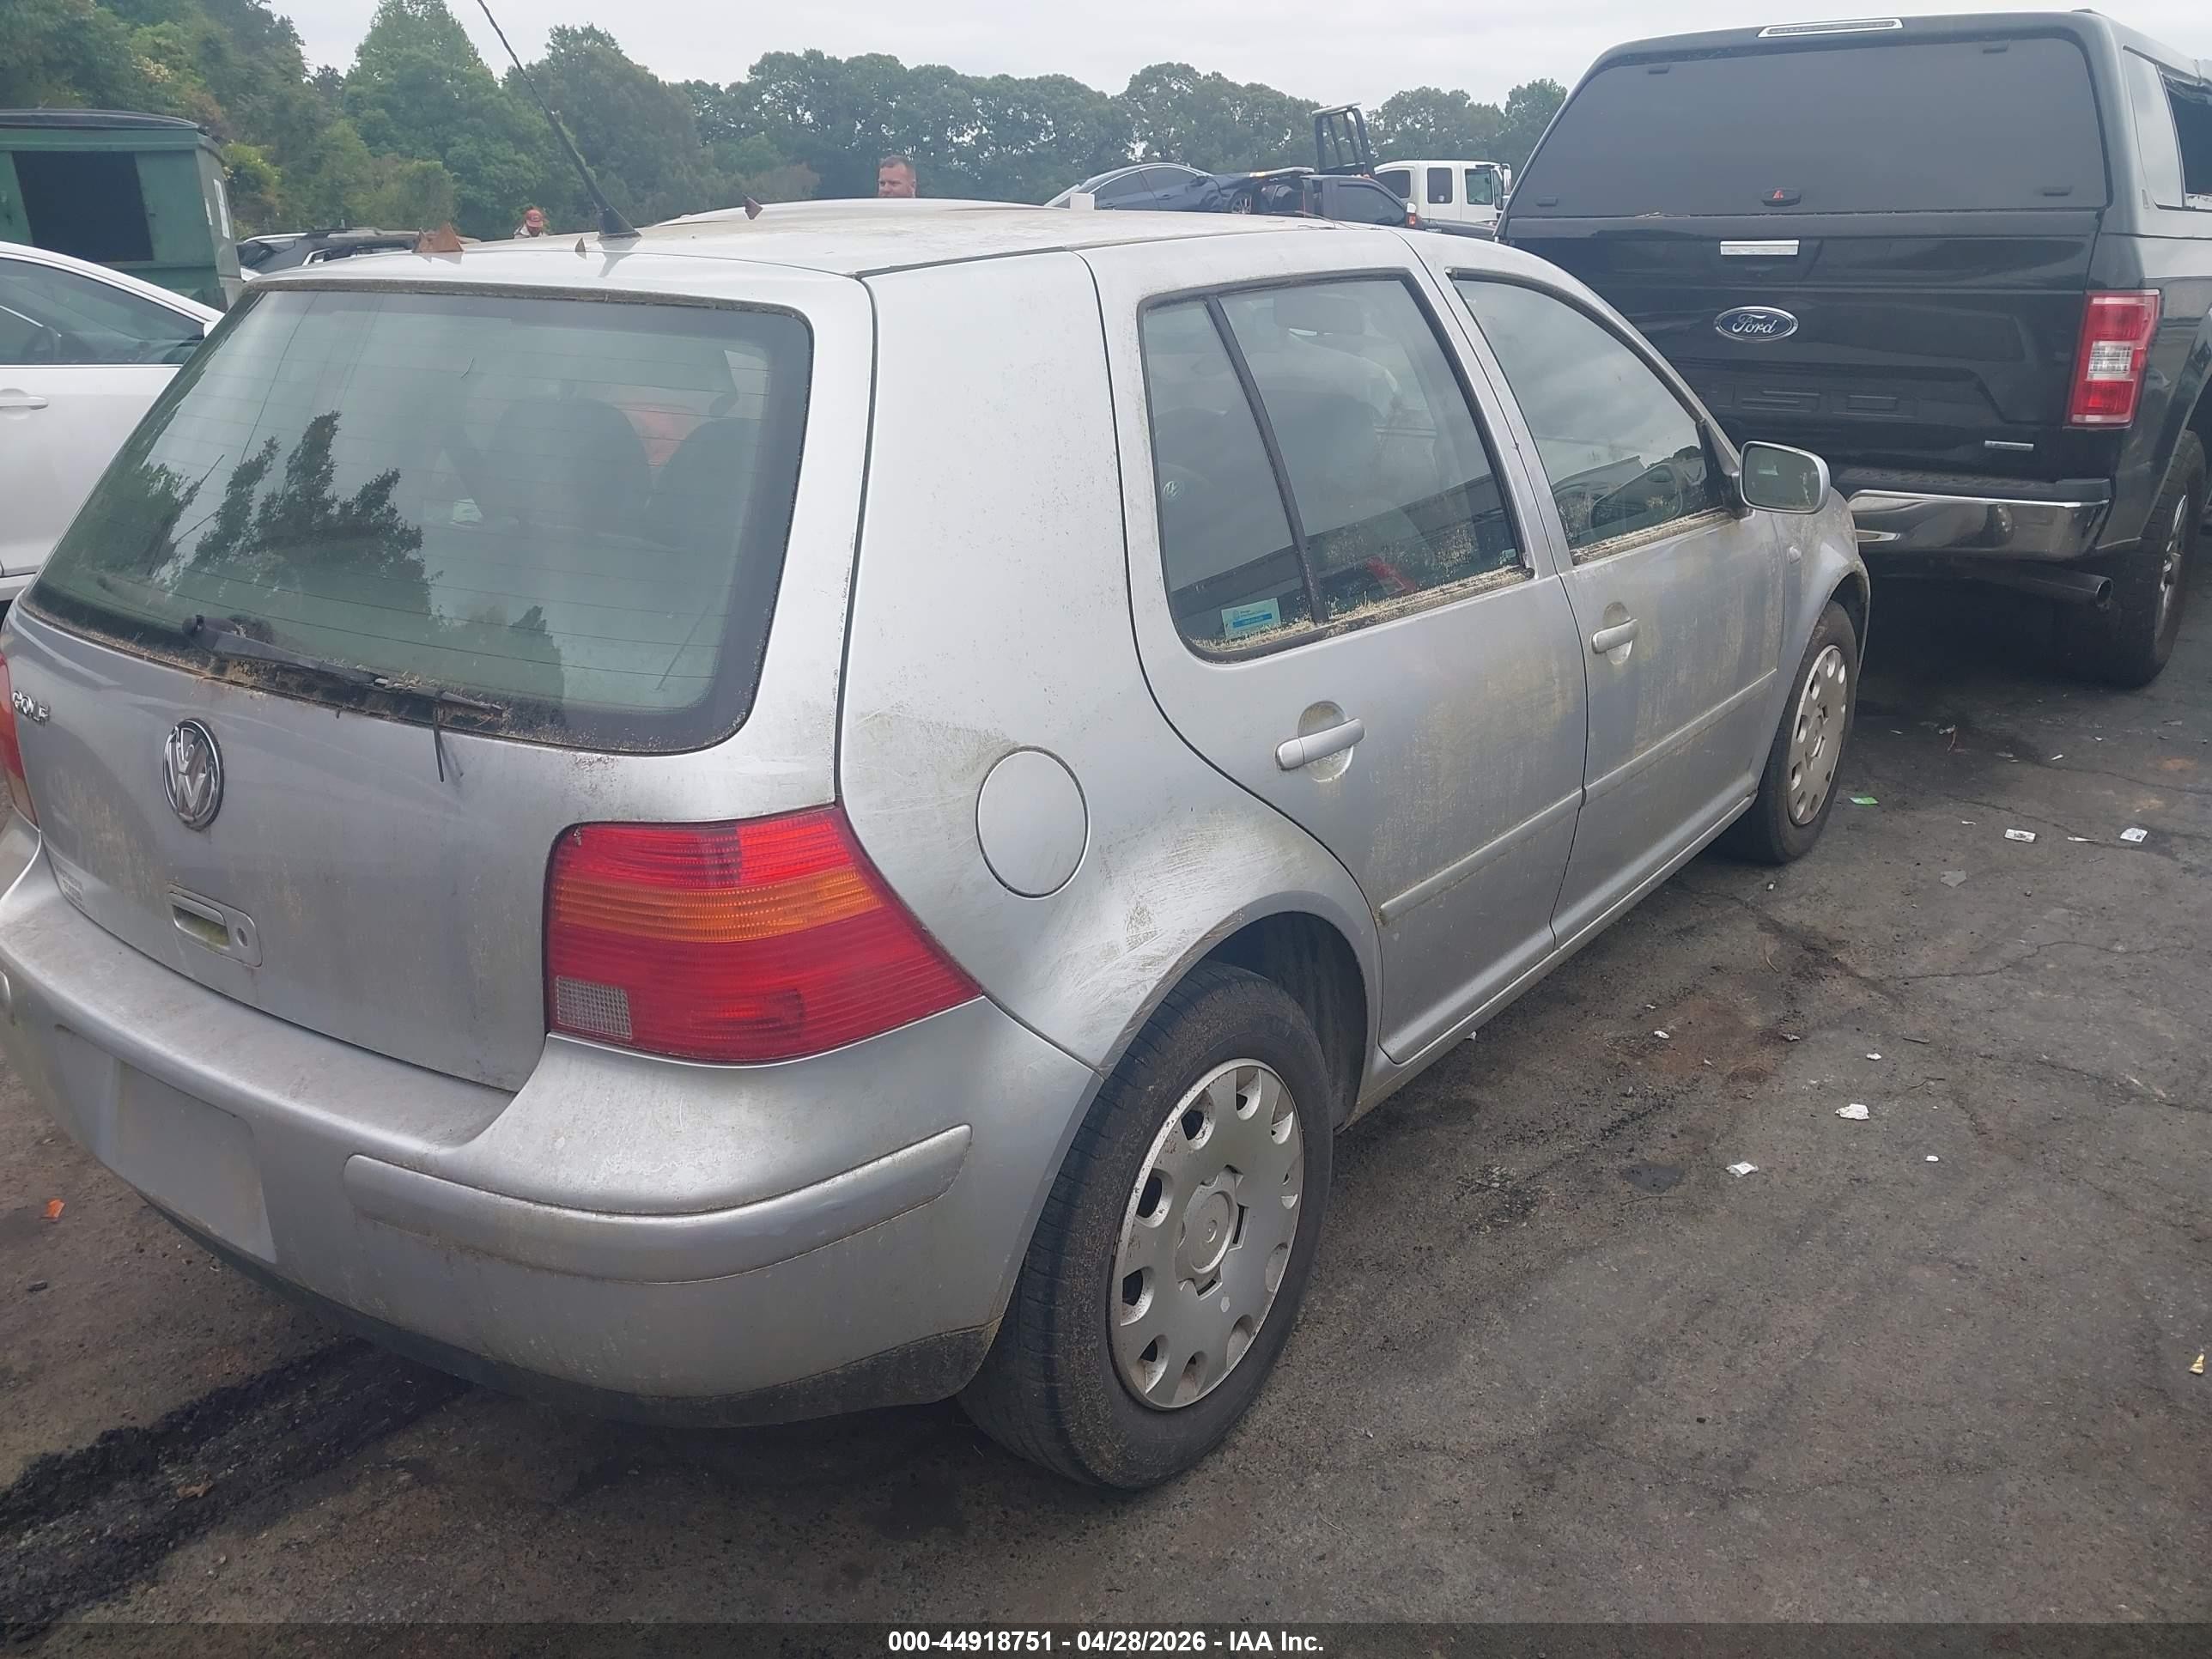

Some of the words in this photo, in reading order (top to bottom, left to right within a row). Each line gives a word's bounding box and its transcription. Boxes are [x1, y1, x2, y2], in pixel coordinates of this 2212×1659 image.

[1731, 313, 1778, 334] Ford
[12, 690, 50, 724] GOLF
[164, 720, 222, 829] VW
